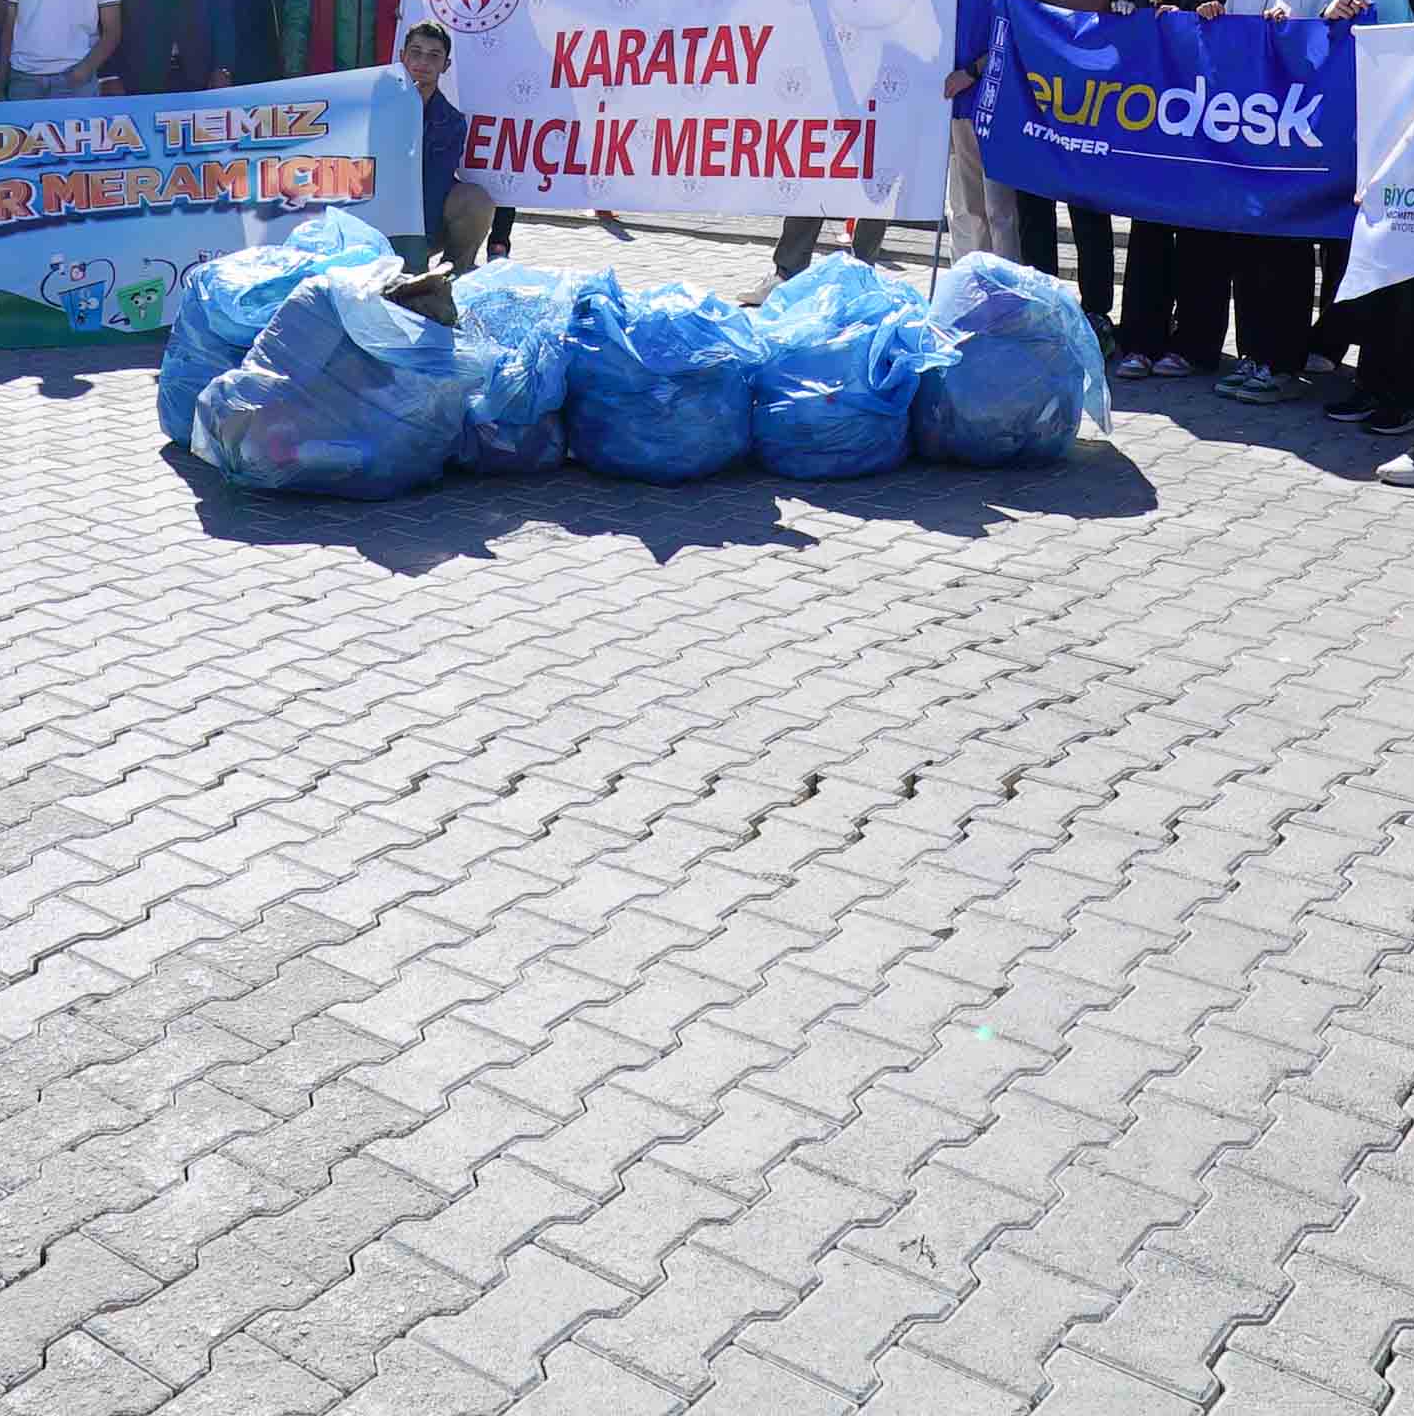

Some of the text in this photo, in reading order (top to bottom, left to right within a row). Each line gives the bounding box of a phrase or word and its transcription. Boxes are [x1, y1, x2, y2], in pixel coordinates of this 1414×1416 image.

[550, 25, 774, 89] KARATAY
[1025, 71, 1324, 148] eurodesk
[464, 99, 877, 192] ENÇLİK MERKEZİ
[39, 157, 251, 214] MERAM
